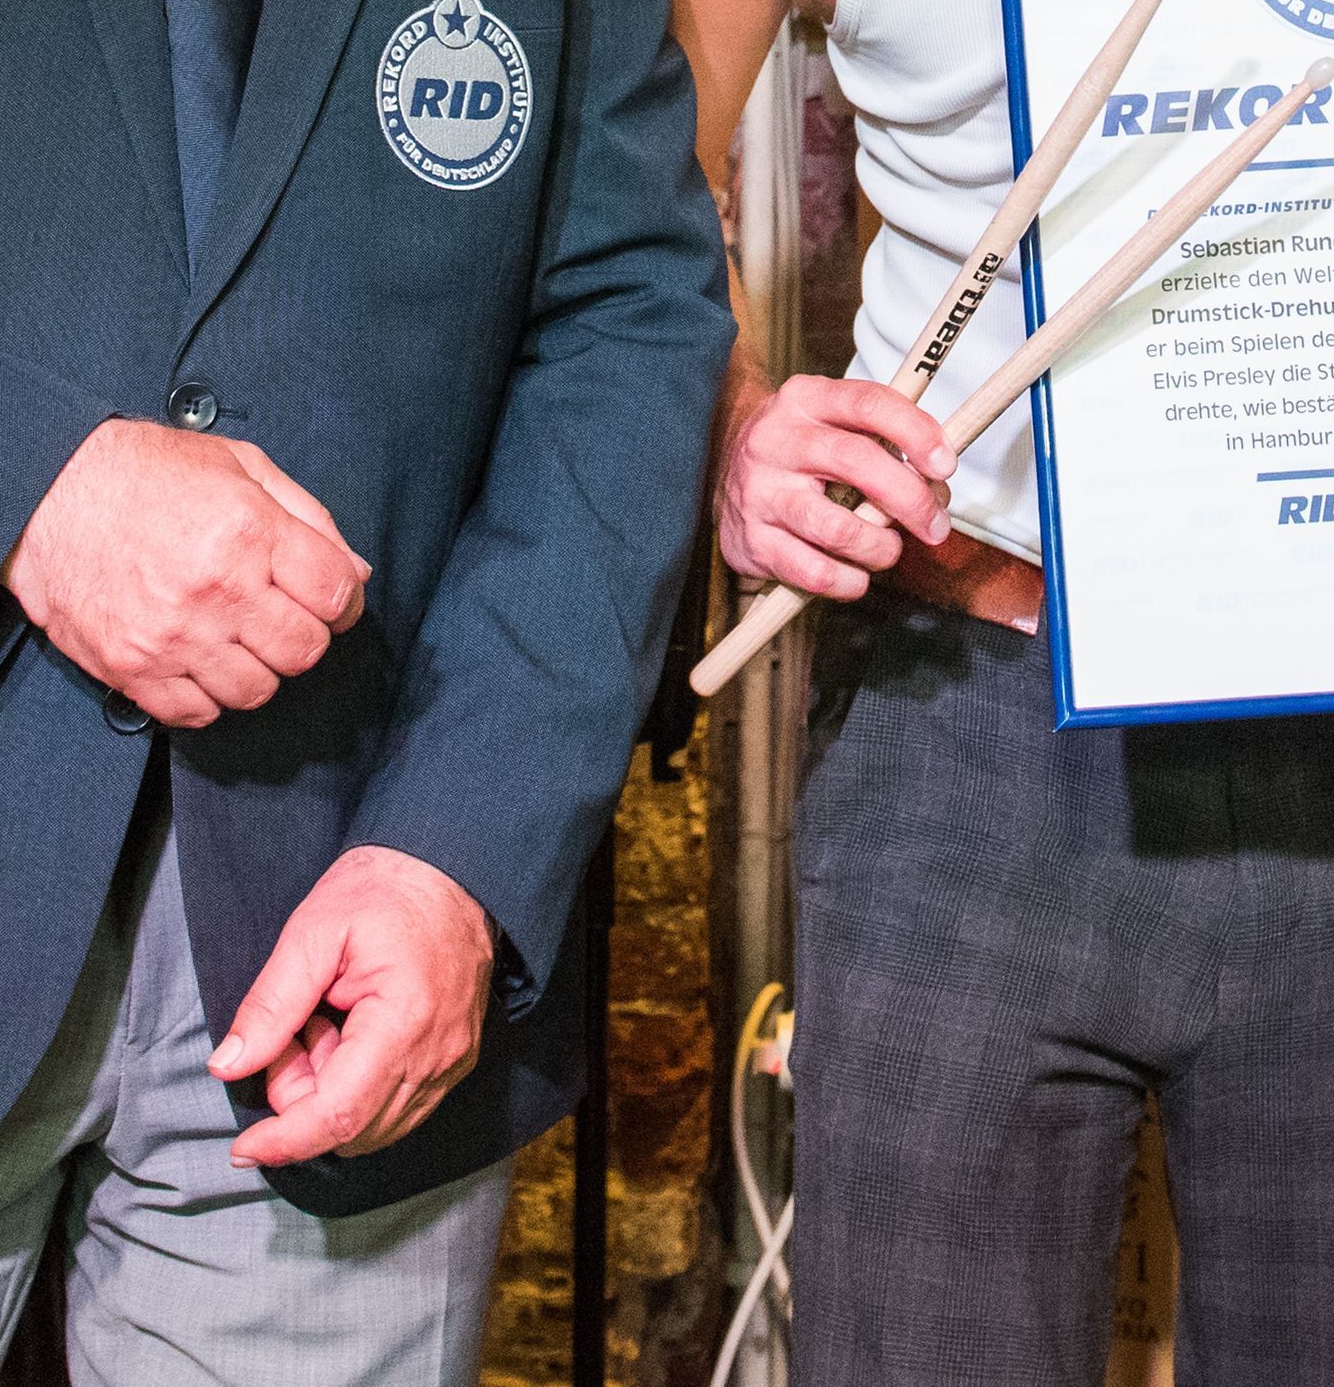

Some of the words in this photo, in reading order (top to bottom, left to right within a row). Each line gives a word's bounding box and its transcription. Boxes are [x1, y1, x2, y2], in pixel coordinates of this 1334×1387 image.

[382, 20, 429, 113] REKORD
[483, 21, 529, 123] INSTITUT
[409, 77, 504, 120] RID
[421, 137, 514, 181] DEUTSCHLAND
[1178, 236, 1286, 261] Sebastian
[1158, 269, 1241, 294] erzielte
[1248, 269, 1287, 287] den
[1146, 343, 1168, 358] er
[1173, 337, 1225, 357] beim
[1231, 333, 1305, 355] Spielen
[1153, 370, 1198, 390] Elvis
[1203, 367, 1276, 387] Presley
[1282, 364, 1312, 383] die
[1165, 402, 1237, 422] drehte,
[1242, 398, 1277, 417] wie
[1226, 433, 1244, 451] in
